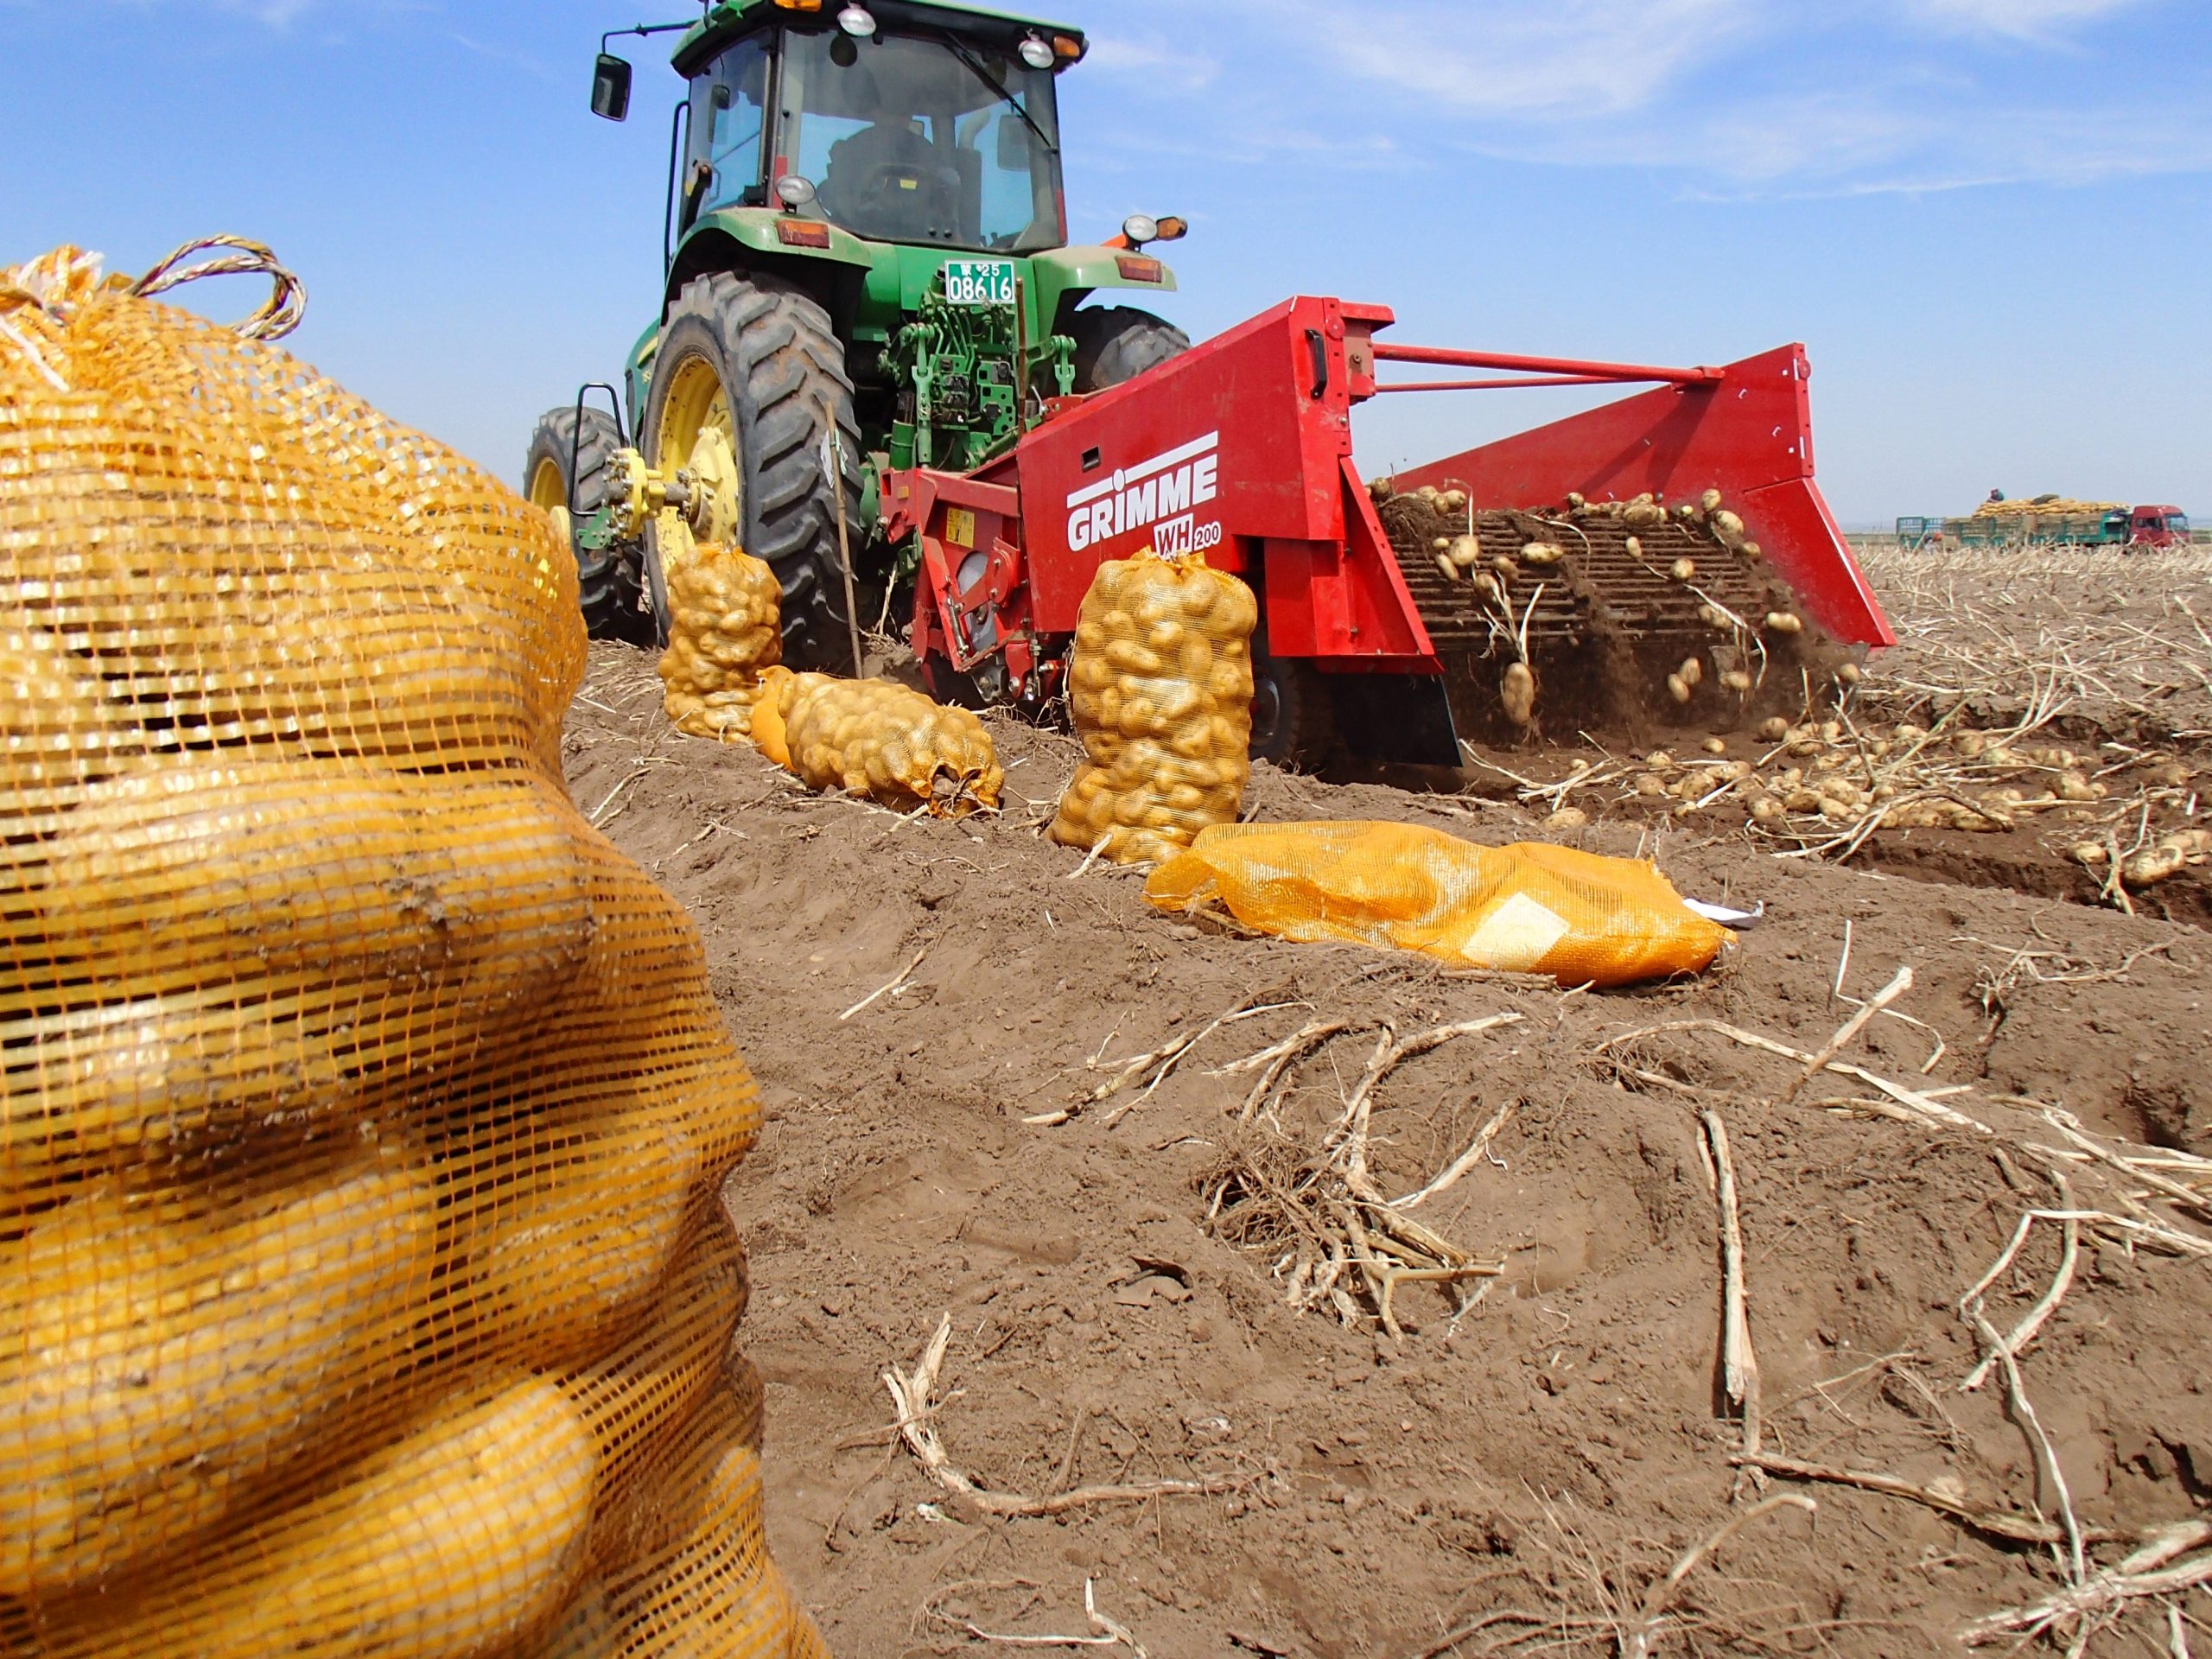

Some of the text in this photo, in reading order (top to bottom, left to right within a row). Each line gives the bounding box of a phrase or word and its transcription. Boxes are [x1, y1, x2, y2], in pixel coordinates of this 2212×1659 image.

[982, 264, 1000, 276] 25
[950, 276, 1012, 300] 08616
[1067, 454, 1217, 552] GRIMME
[1156, 519, 1219, 556] WH 200
